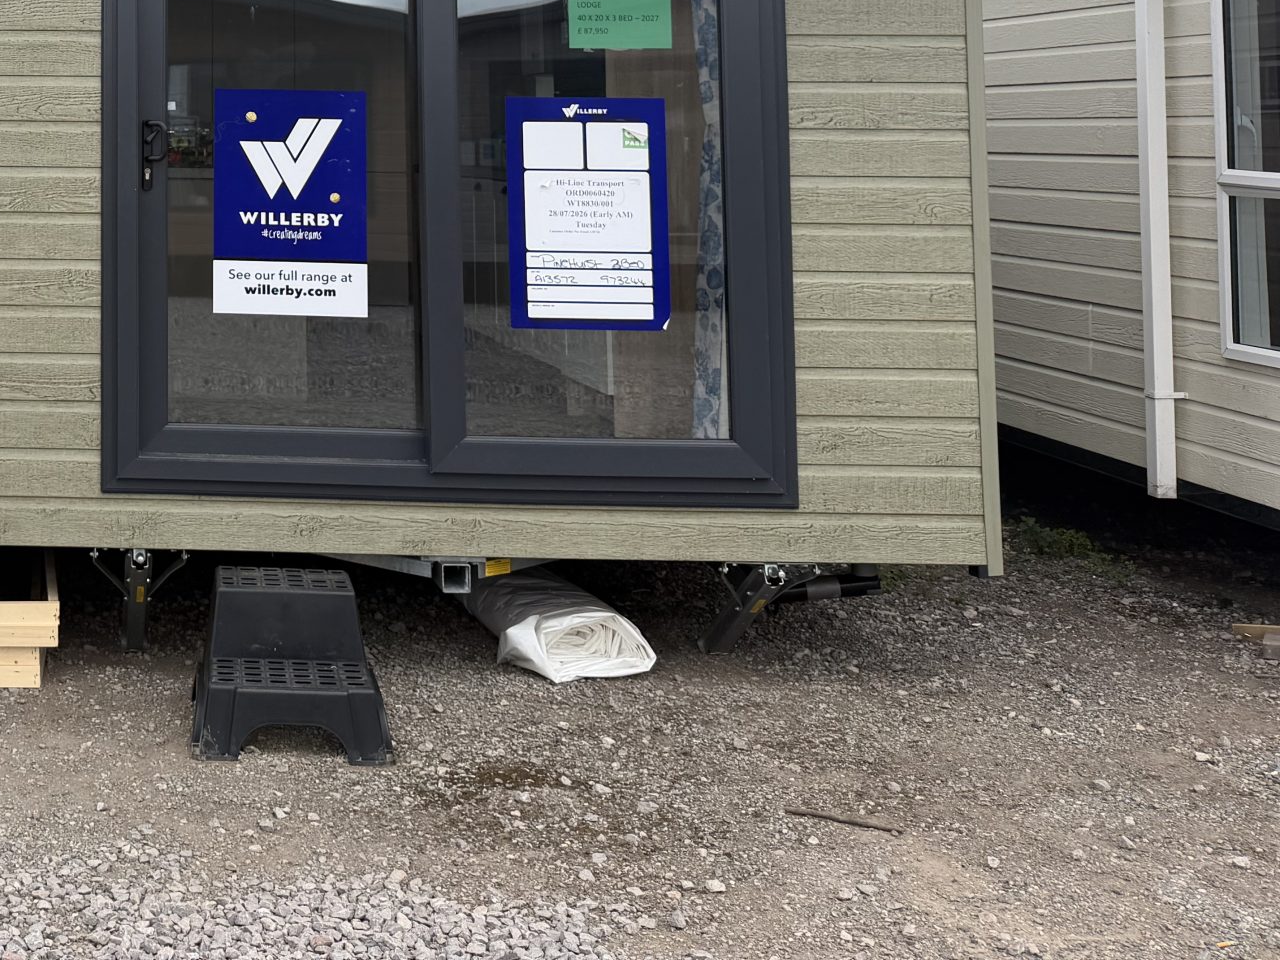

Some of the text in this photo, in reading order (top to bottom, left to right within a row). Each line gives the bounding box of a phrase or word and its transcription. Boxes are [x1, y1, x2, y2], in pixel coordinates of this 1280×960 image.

[577, 1, 602, 9] LODGE
[577, 14, 587, 22] 40
[595, 14, 604, 22] 20
[618, 14, 633, 22] BED
[641, 14, 659, 22] 2027
[584, 27, 609, 36] 87,950
[586, 179, 624, 188] Transport
[239, 211, 343, 227] WILLERBY
[549, 210, 633, 219] 28/07/2026 (Early AM)
[576, 221, 606, 230] Tuesday
[261, 228, 322, 244] #creatingdreams
[228, 269, 352, 284] See our full range at
[244, 284, 336, 299] willerby.com
